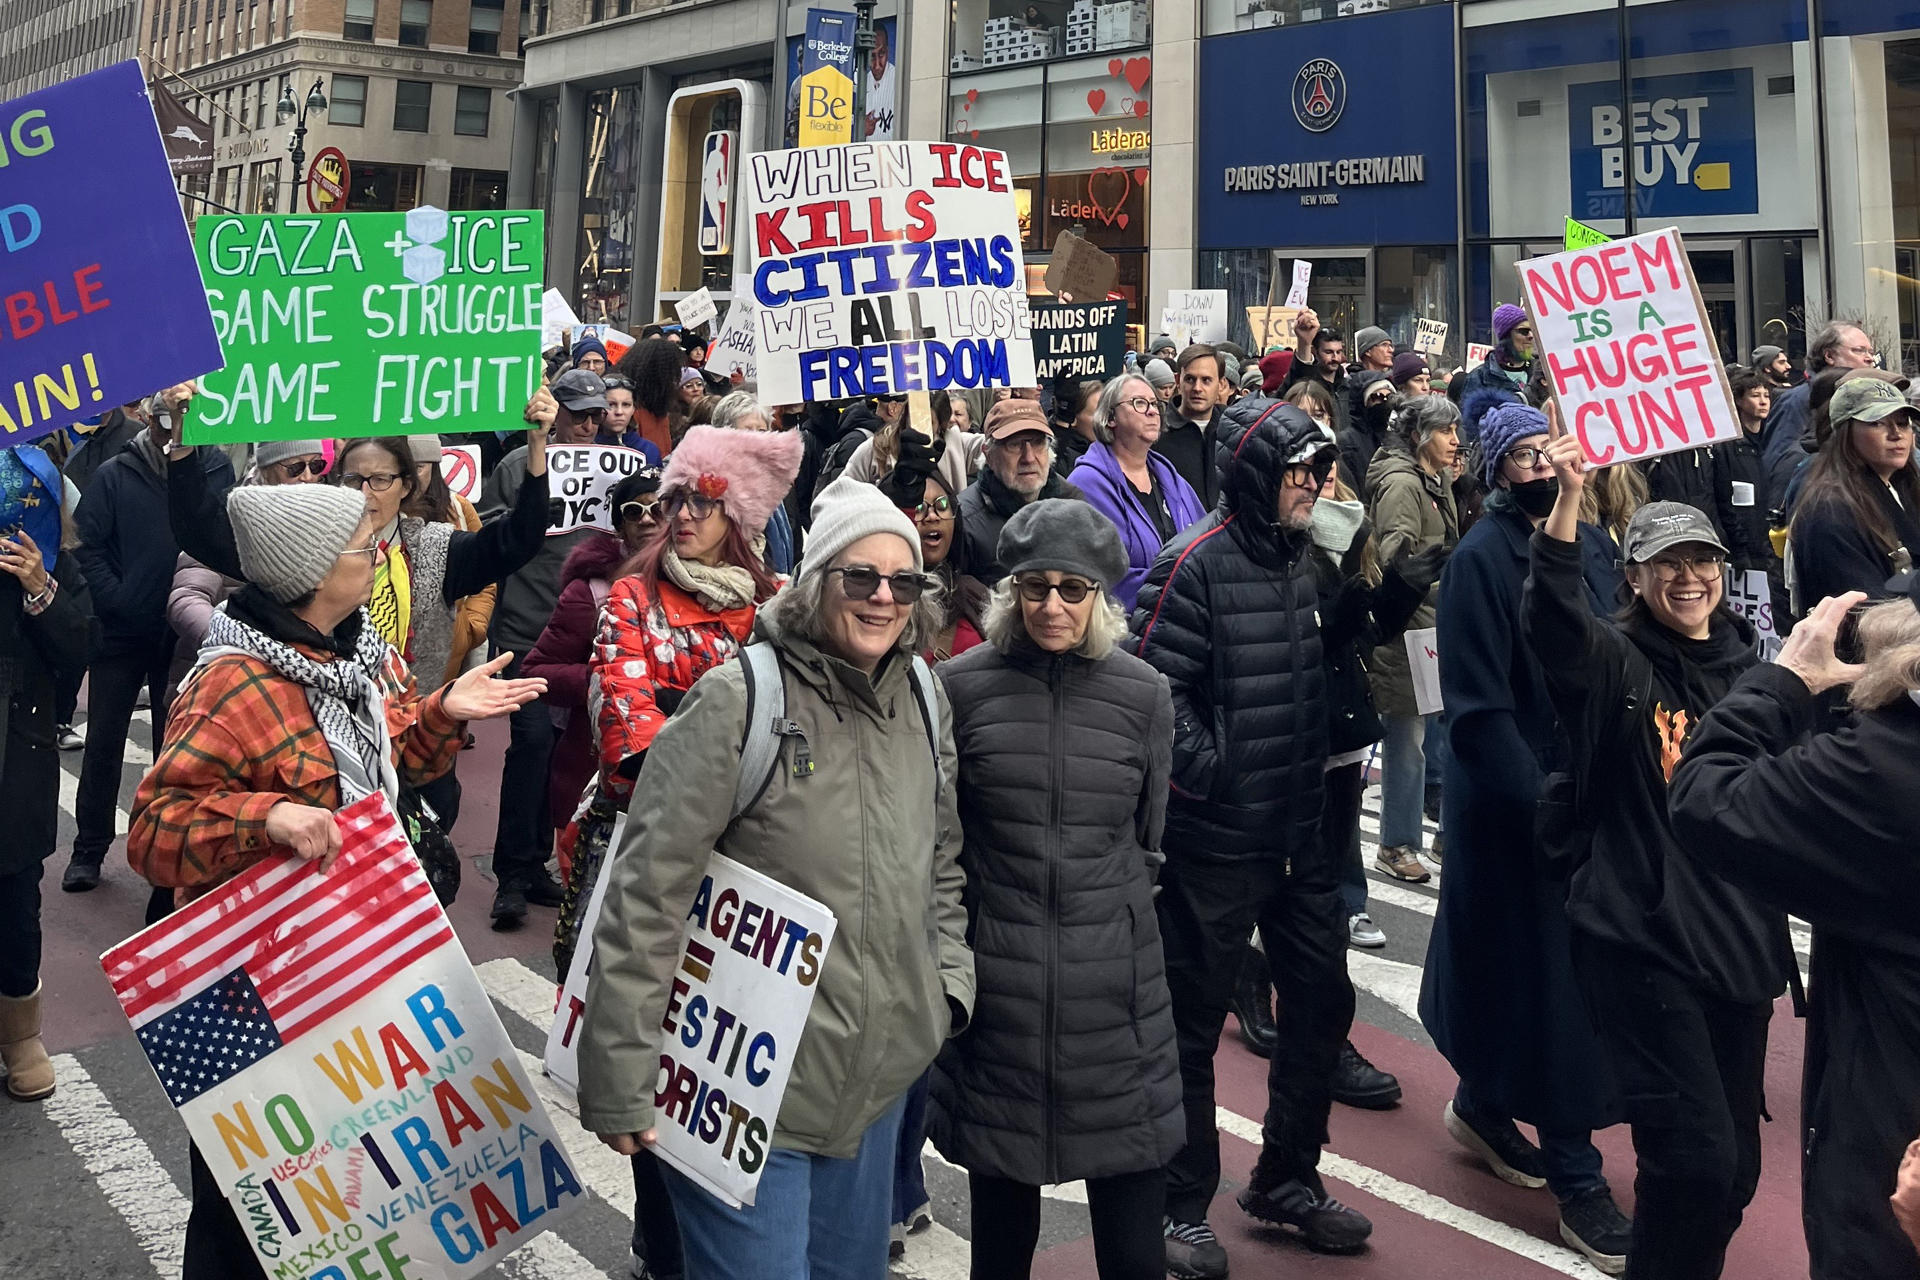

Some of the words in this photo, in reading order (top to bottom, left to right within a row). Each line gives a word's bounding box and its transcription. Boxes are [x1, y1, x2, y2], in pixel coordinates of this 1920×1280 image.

[817, 41, 852, 55] Berkeley
[818, 50, 849, 64] College
[1301, 62, 1336, 79] PARIS
[805, 85, 847, 120] Be
[809, 120, 844, 132] flexible
[1592, 97, 1708, 145] BEST
[0, 109, 55, 168] G
[229, 138, 268, 160] BUILDING
[1601, 142, 1700, 188] BUY
[751, 144, 913, 203] WHEN
[928, 143, 1008, 193] ICE
[1225, 164, 1276, 192] PARIS
[1277, 154, 1424, 188] SAINT-GERMAIN
[1300, 194, 1317, 206] NEW
[1318, 193, 1339, 205] YORK
[755, 189, 937, 257] KILLS
[1051, 199, 1097, 219] Läder
[209, 218, 364, 276] GAZA
[448, 216, 530, 274] ICE
[0, 263, 111, 340] BLE
[1183, 293, 1214, 310] DOWN
[1526, 235, 1681, 317] NOEM
[207, 285, 333, 345] SAME
[362, 283, 544, 338] STRUGGLE
[719, 326, 755, 356] ASHA
[760, 302, 838, 353] WE
[850, 291, 936, 346] ALL
[945, 290, 1033, 341] LOSE
[1029, 308, 1085, 329] HANDS
[1089, 305, 1117, 327] OFF
[1189, 313, 1208, 326] WITH
[1420, 334, 1436, 345] ICE
[1568, 309, 1612, 343] IS
[1638, 301, 1665, 331] A
[798, 338, 1011, 402] FREEDOM
[1036, 354, 1105, 378] AMERICA
[1049, 332, 1097, 354] LATIN
[1547, 323, 1709, 396] HUGE
[196, 361, 341, 426] SAME
[1575, 375, 1716, 465] CUNT
[546, 450, 590, 473] ICE
[599, 451, 644, 475] OUT
[562, 477, 594, 496] OF
[687, 875, 822, 987] AGENTS
[662, 975, 777, 1088] ESTIC
[212, 1093, 315, 1171] NO
[313, 983, 465, 1105] WAR
[330, 1045, 475, 1150] GREENLAND
[561, 994, 585, 1048] T
[654, 1053, 769, 1175] ORISTS
[262, 1163, 352, 1237] IN
[360, 1057, 533, 1190] IRAN
[272, 1158, 299, 1182] US
[297, 1139, 333, 1174] Cities
[343, 1146, 365, 1209] PANAMA
[366, 1123, 539, 1230] VENEZUELA
[429, 1139, 583, 1265] GAZA
[235, 1172, 283, 1259] CANADA
[272, 1223, 363, 1280] MEXICO
